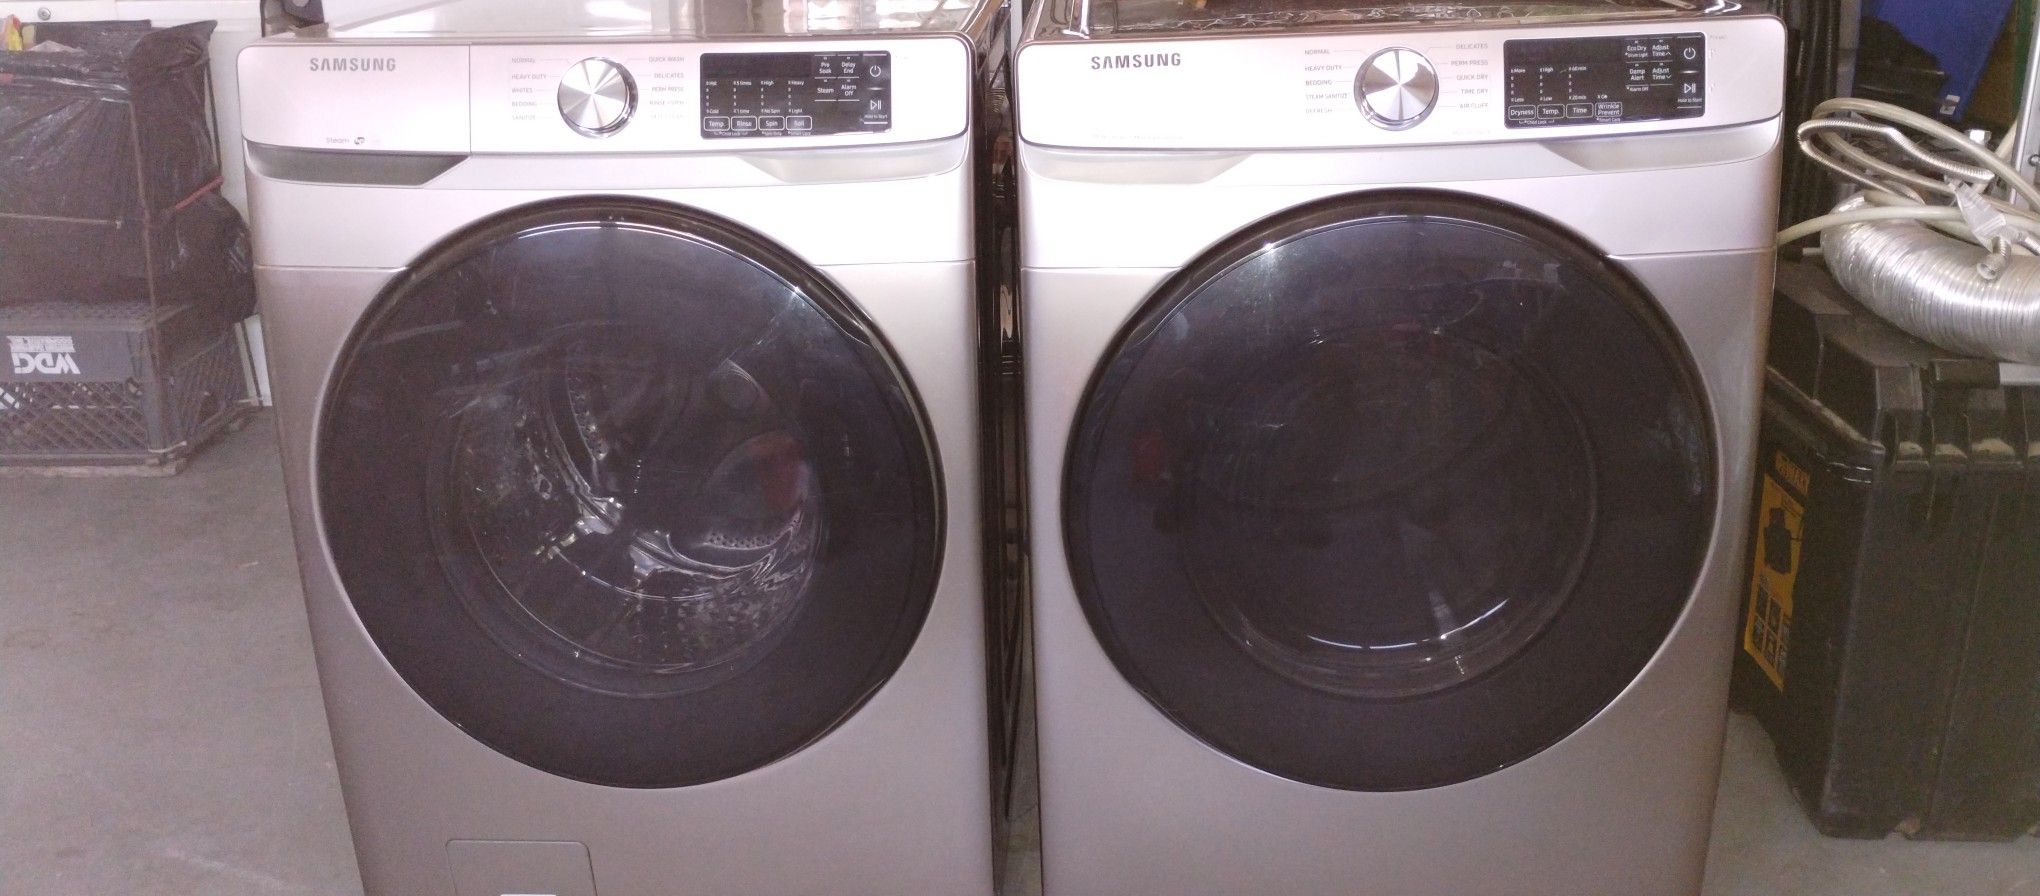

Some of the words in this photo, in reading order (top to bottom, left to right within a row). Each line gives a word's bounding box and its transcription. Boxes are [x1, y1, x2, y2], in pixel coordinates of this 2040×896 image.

[310, 57, 396, 72] SAMSUNG
[1091, 52, 1181, 70] SAMSUNG
[1510, 109, 1534, 117] Dryness
[1542, 108, 1560, 116] Temp.
[765, 120, 778, 128] Spin
[326, 136, 350, 144] Steam
[11, 352, 81, 375] WDG
